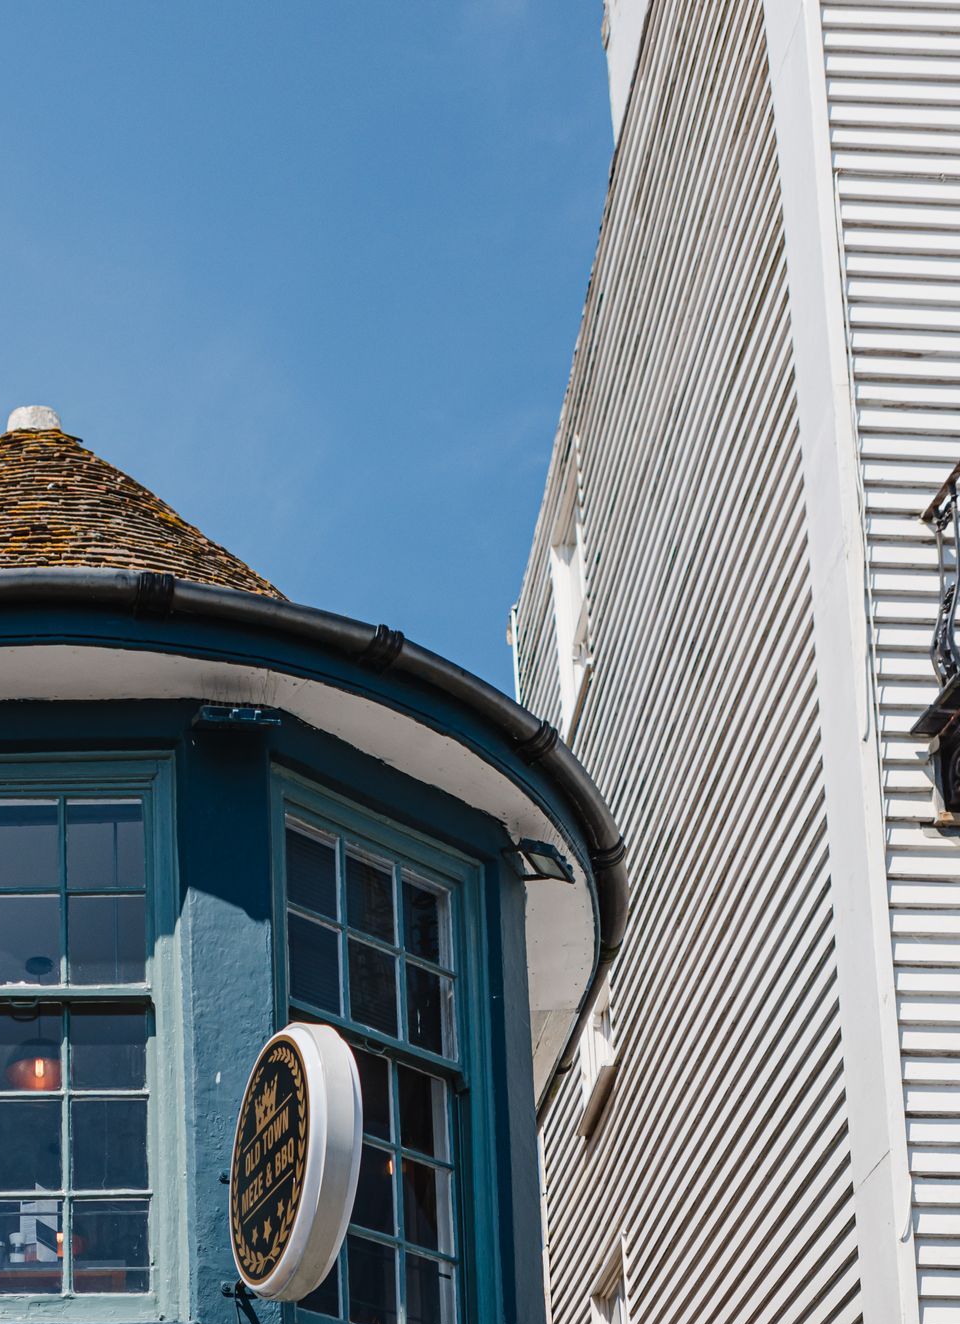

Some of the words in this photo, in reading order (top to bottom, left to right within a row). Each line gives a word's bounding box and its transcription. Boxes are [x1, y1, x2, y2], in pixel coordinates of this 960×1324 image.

[241, 1172, 264, 1217] MEZE
[265, 1165, 274, 1190] &
[274, 1137, 295, 1178] BBQ
[244, 1141, 261, 1177] OLD
[262, 1105, 290, 1156] TOWN
